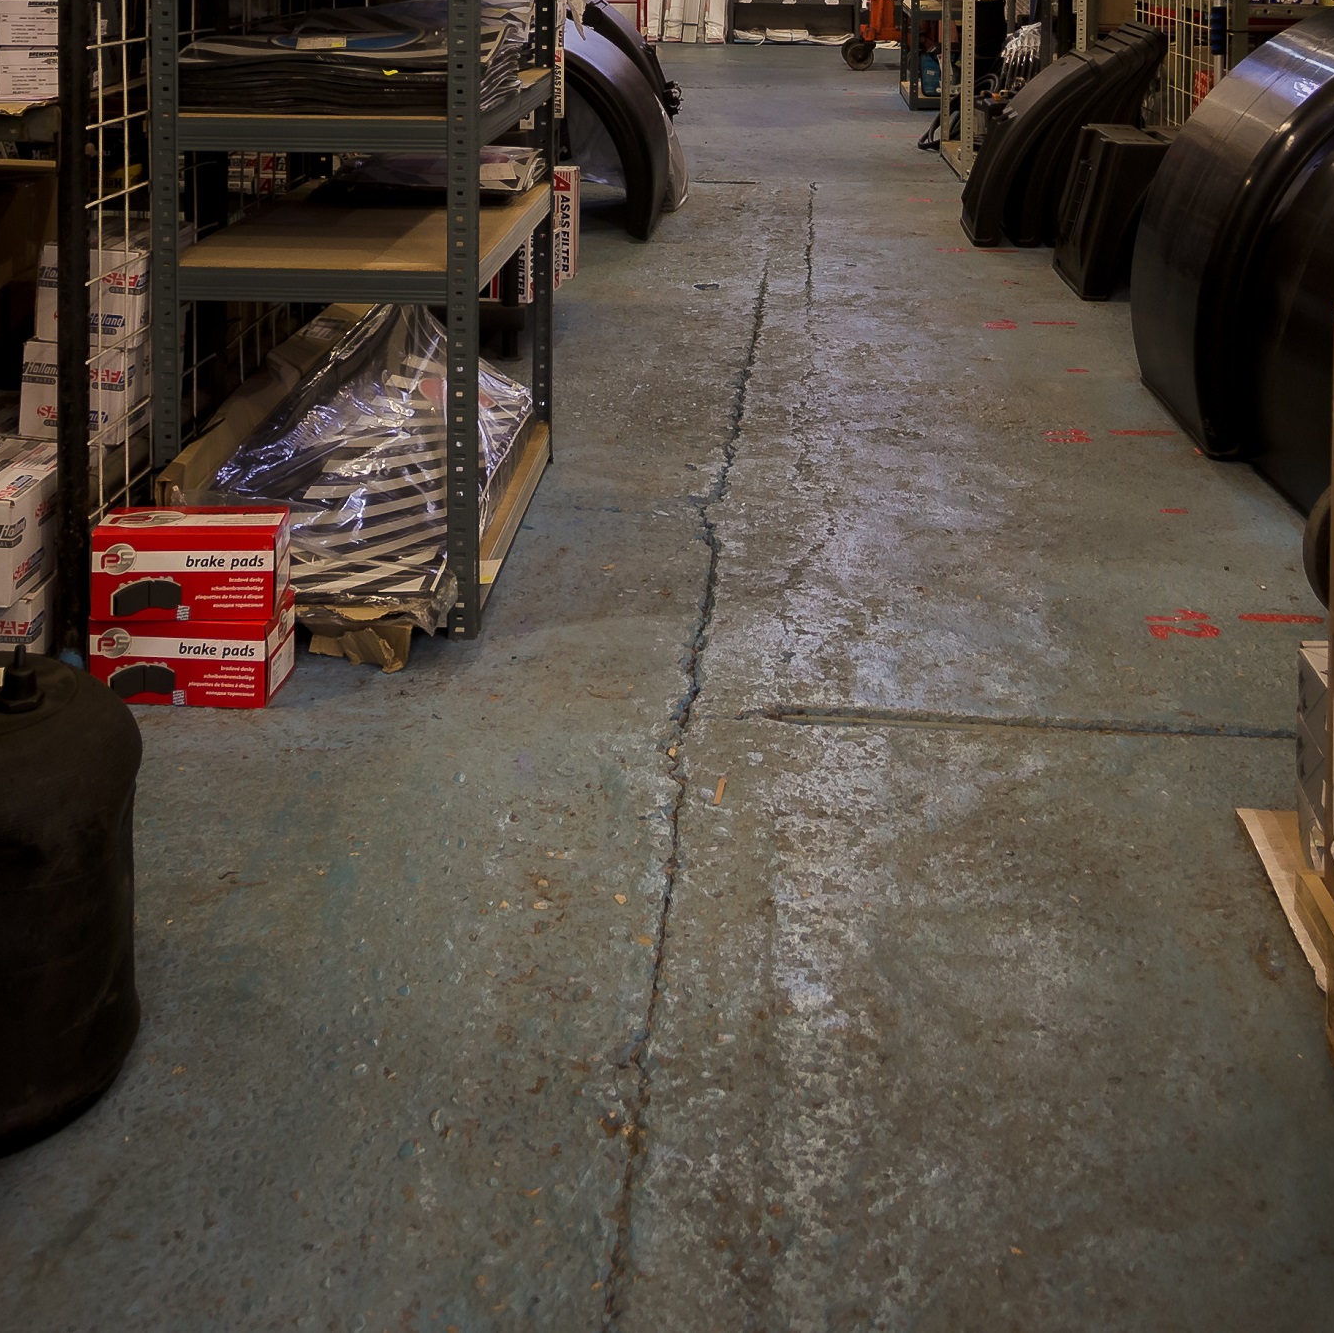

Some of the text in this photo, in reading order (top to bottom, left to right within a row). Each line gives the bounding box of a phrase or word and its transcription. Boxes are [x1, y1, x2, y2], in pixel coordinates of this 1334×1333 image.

[560, 193, 571, 274] ASAS FILTER
[186, 555, 264, 570] brake pads
[178, 643, 255, 658] brake pads
